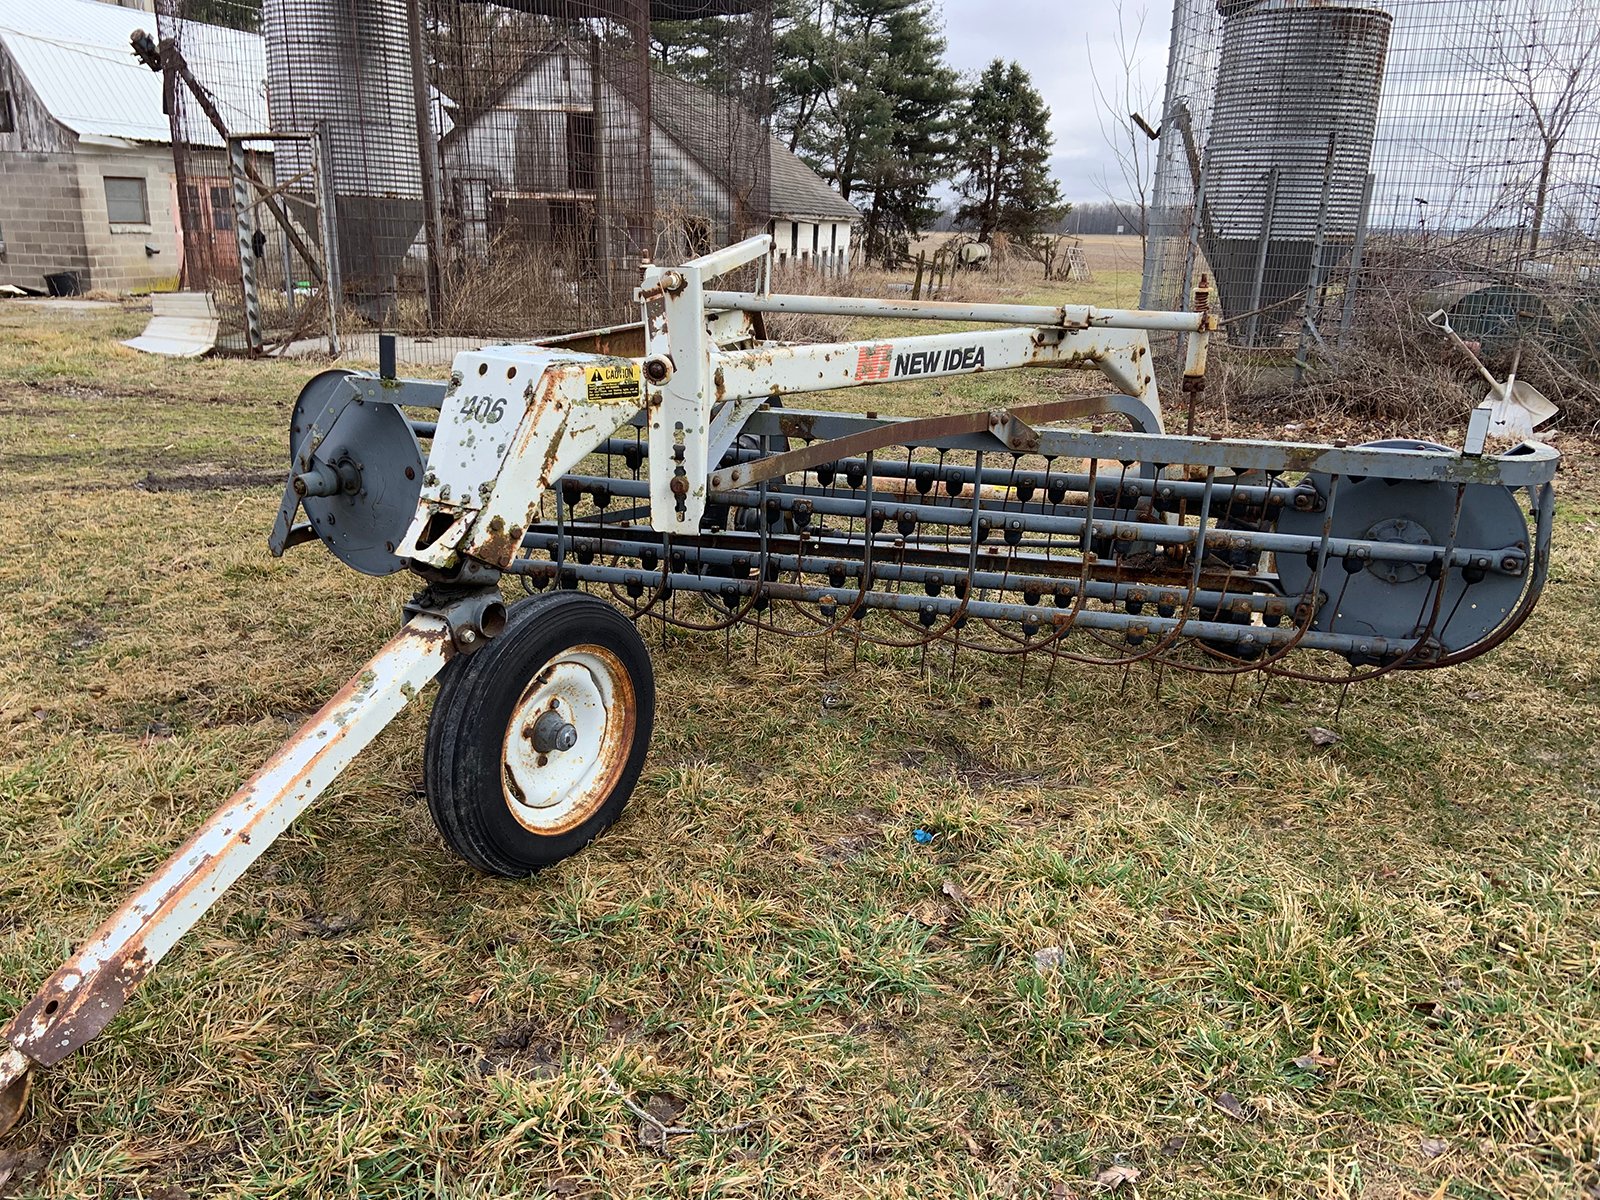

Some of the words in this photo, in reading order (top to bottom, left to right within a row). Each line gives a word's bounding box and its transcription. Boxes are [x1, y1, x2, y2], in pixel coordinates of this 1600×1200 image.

[605, 367, 634, 380] CAUTION
[894, 350, 942, 377] NEW
[943, 345, 985, 372] IDEA
[460, 396, 507, 424] 406
